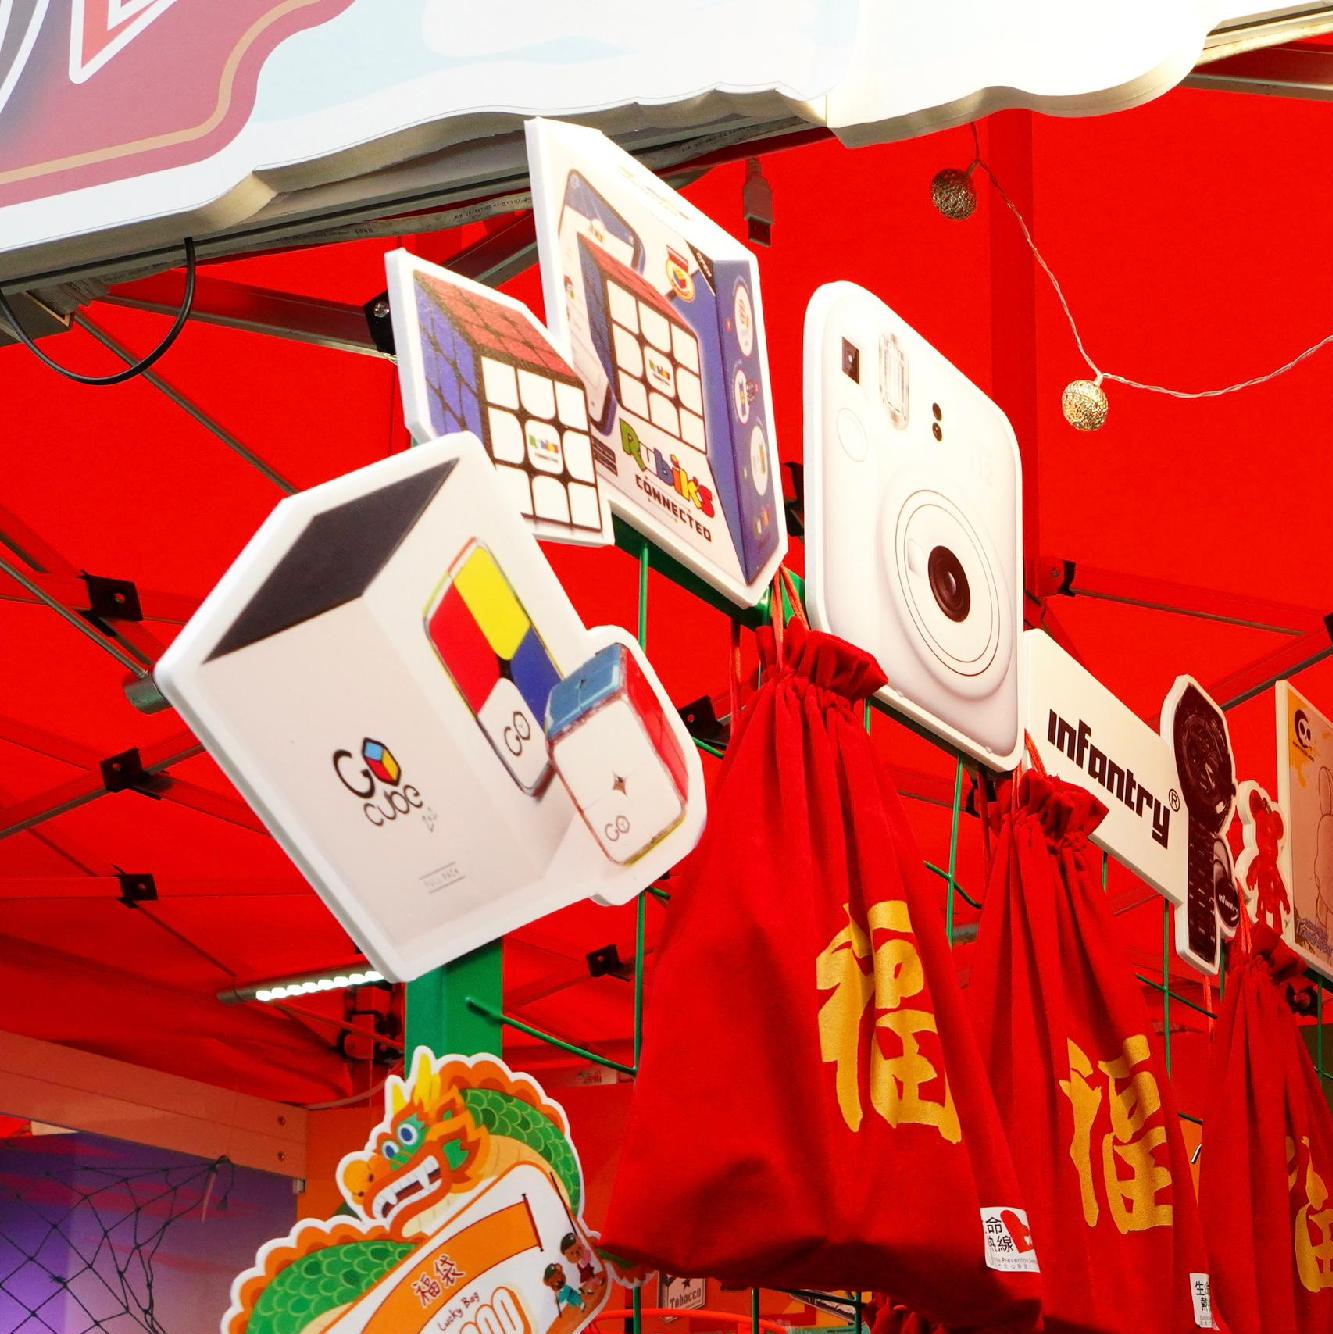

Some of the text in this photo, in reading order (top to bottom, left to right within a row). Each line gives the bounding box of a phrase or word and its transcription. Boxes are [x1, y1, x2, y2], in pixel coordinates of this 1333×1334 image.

[634, 473, 713, 543] CONNECTED
[815, 900, 962, 1144] 福
[1058, 1034, 1174, 1235] 福
[985, 1216, 1003, 1234] 命
[411, 1254, 465, 1308] 福袋
[436, 1290, 481, 1332] Lucky Bag
